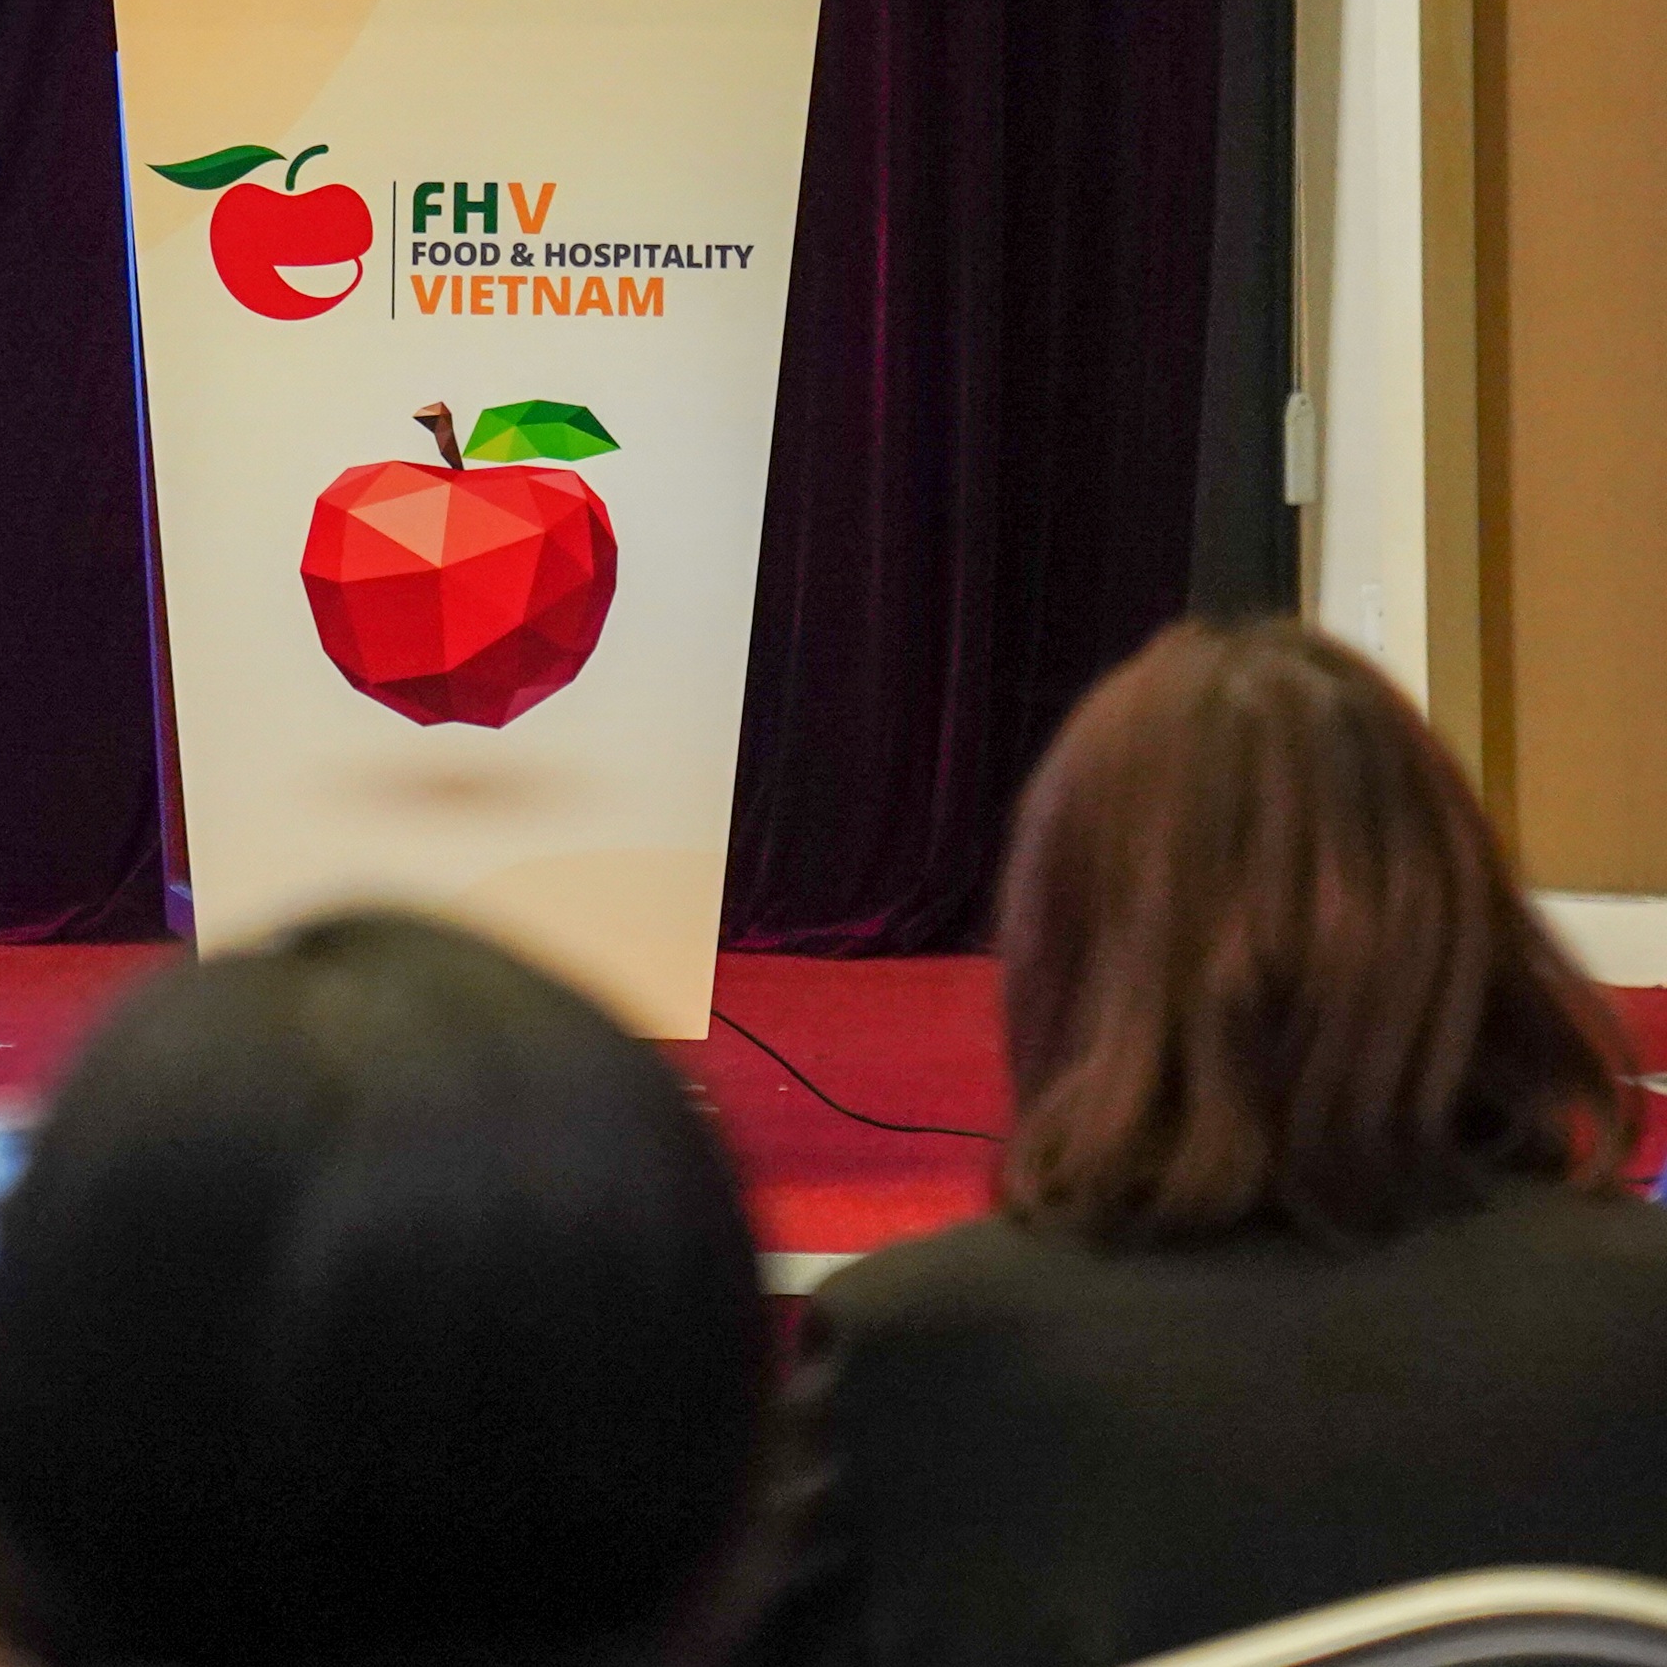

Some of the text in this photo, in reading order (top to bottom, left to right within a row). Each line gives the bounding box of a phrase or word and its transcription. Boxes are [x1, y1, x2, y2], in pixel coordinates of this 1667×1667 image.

[411, 182, 557, 234] FHV
[411, 241, 754, 269] FOOD & HOSPITALITY
[410, 275, 665, 317] VIETNAM
